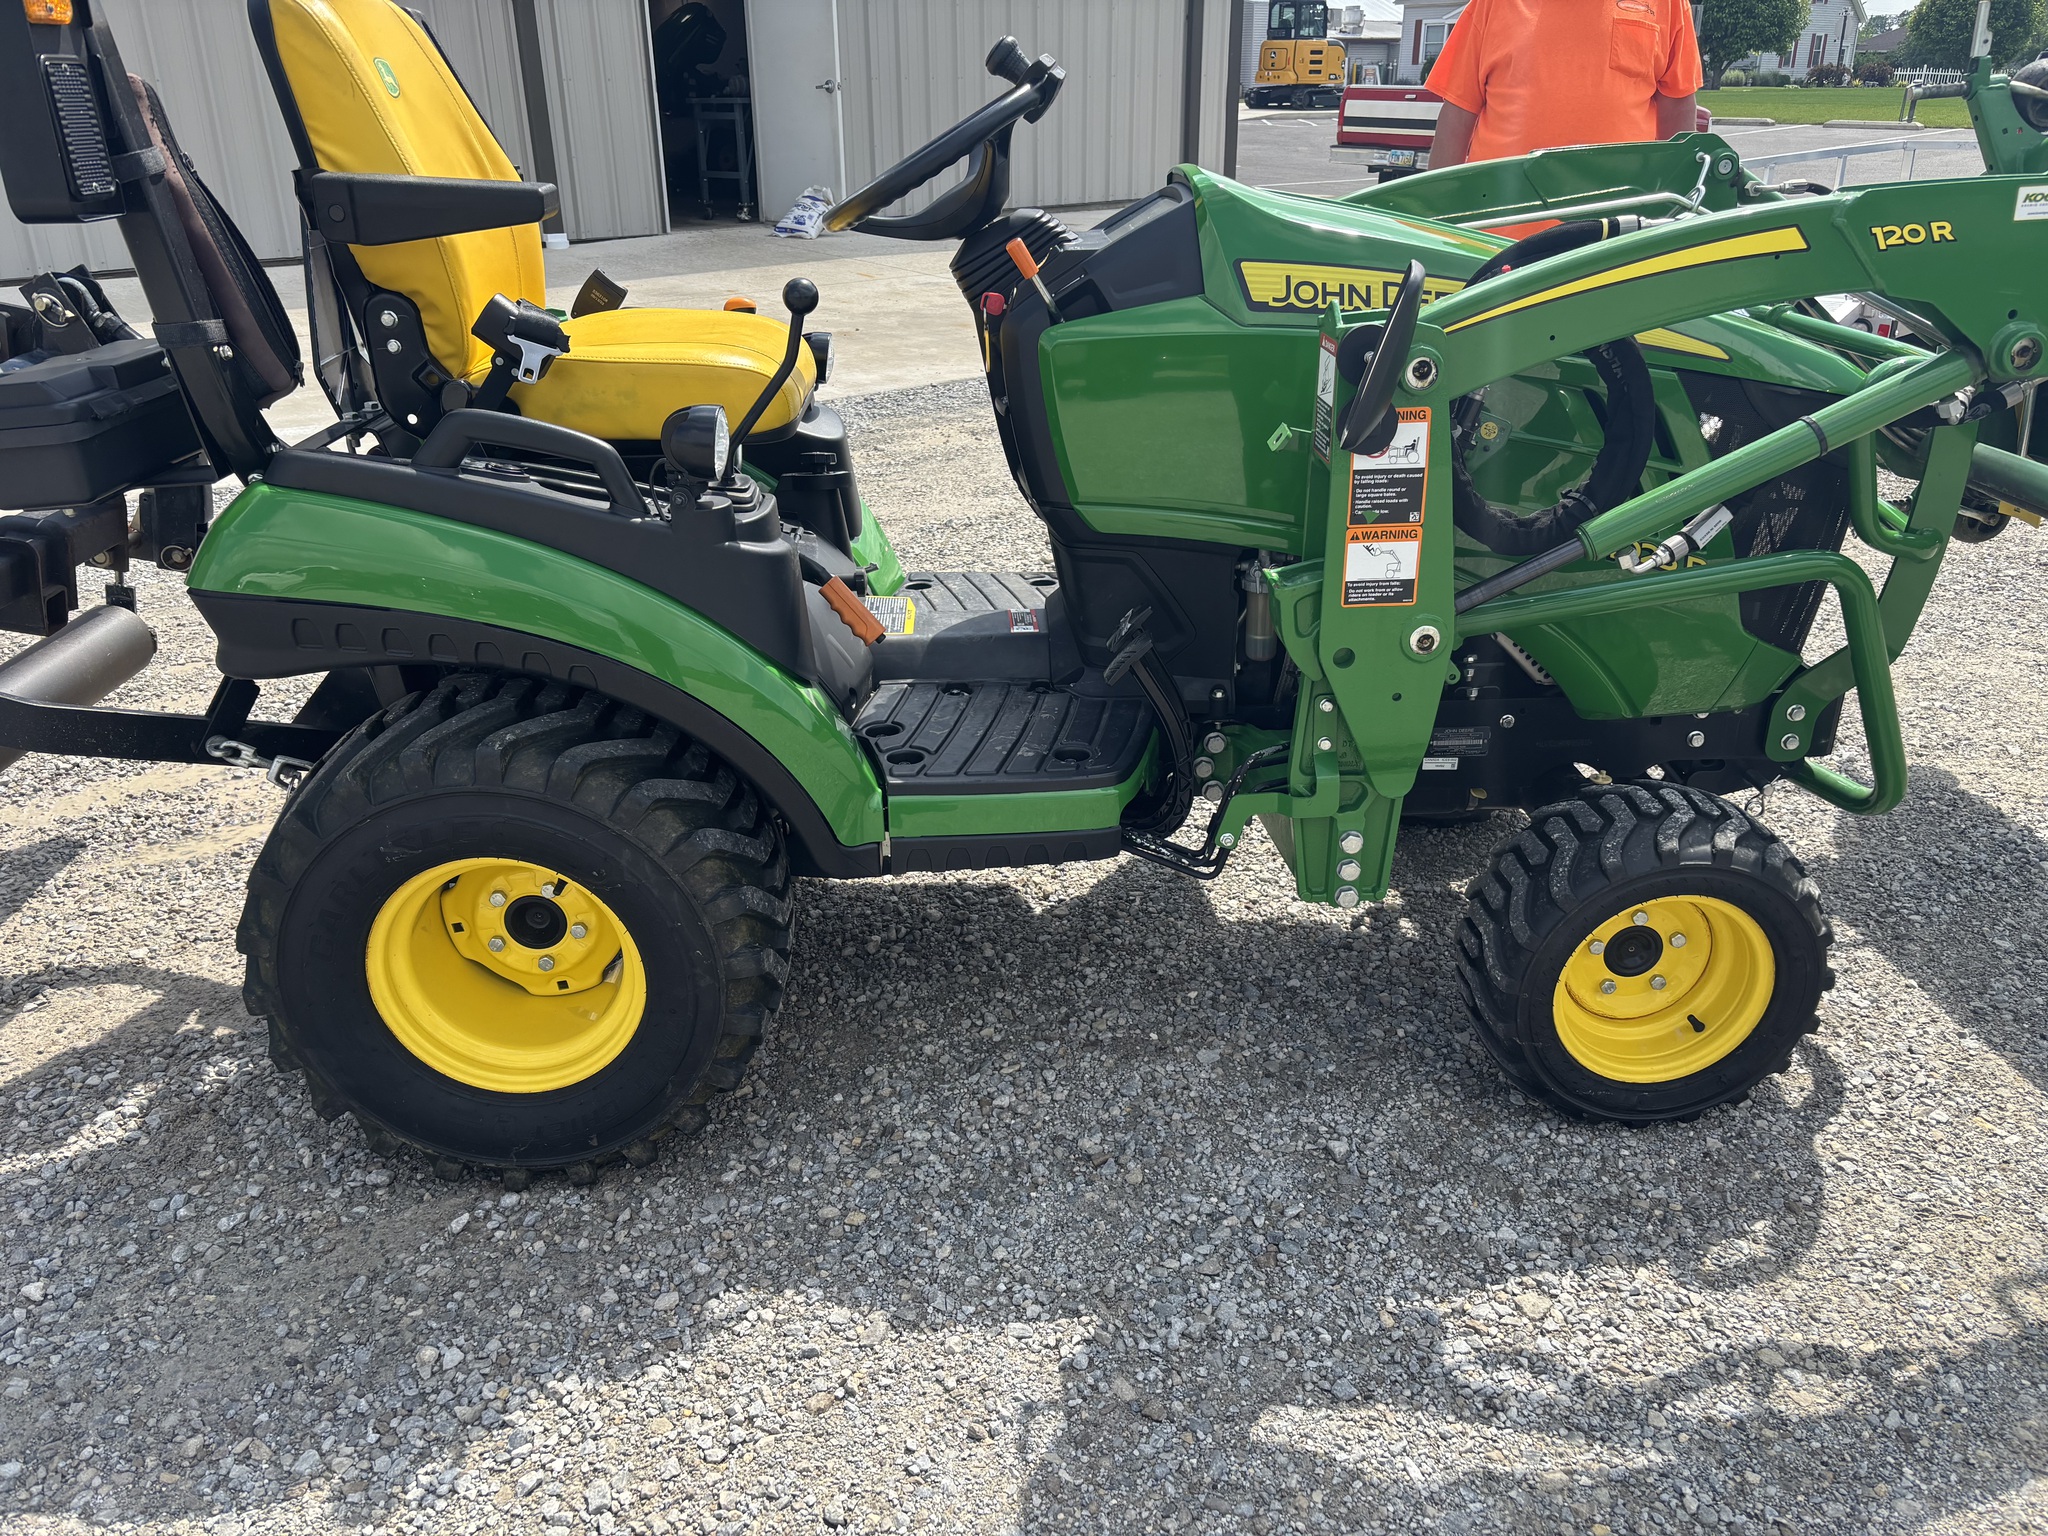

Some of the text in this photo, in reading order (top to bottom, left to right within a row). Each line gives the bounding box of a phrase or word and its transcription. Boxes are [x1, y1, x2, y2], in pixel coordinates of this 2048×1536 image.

[1870, 221, 1957, 251] 120 R
[1272, 274, 1372, 308] JOHN
[1398, 410, 1427, 421] NING
[1361, 530, 1418, 540] WARNING
